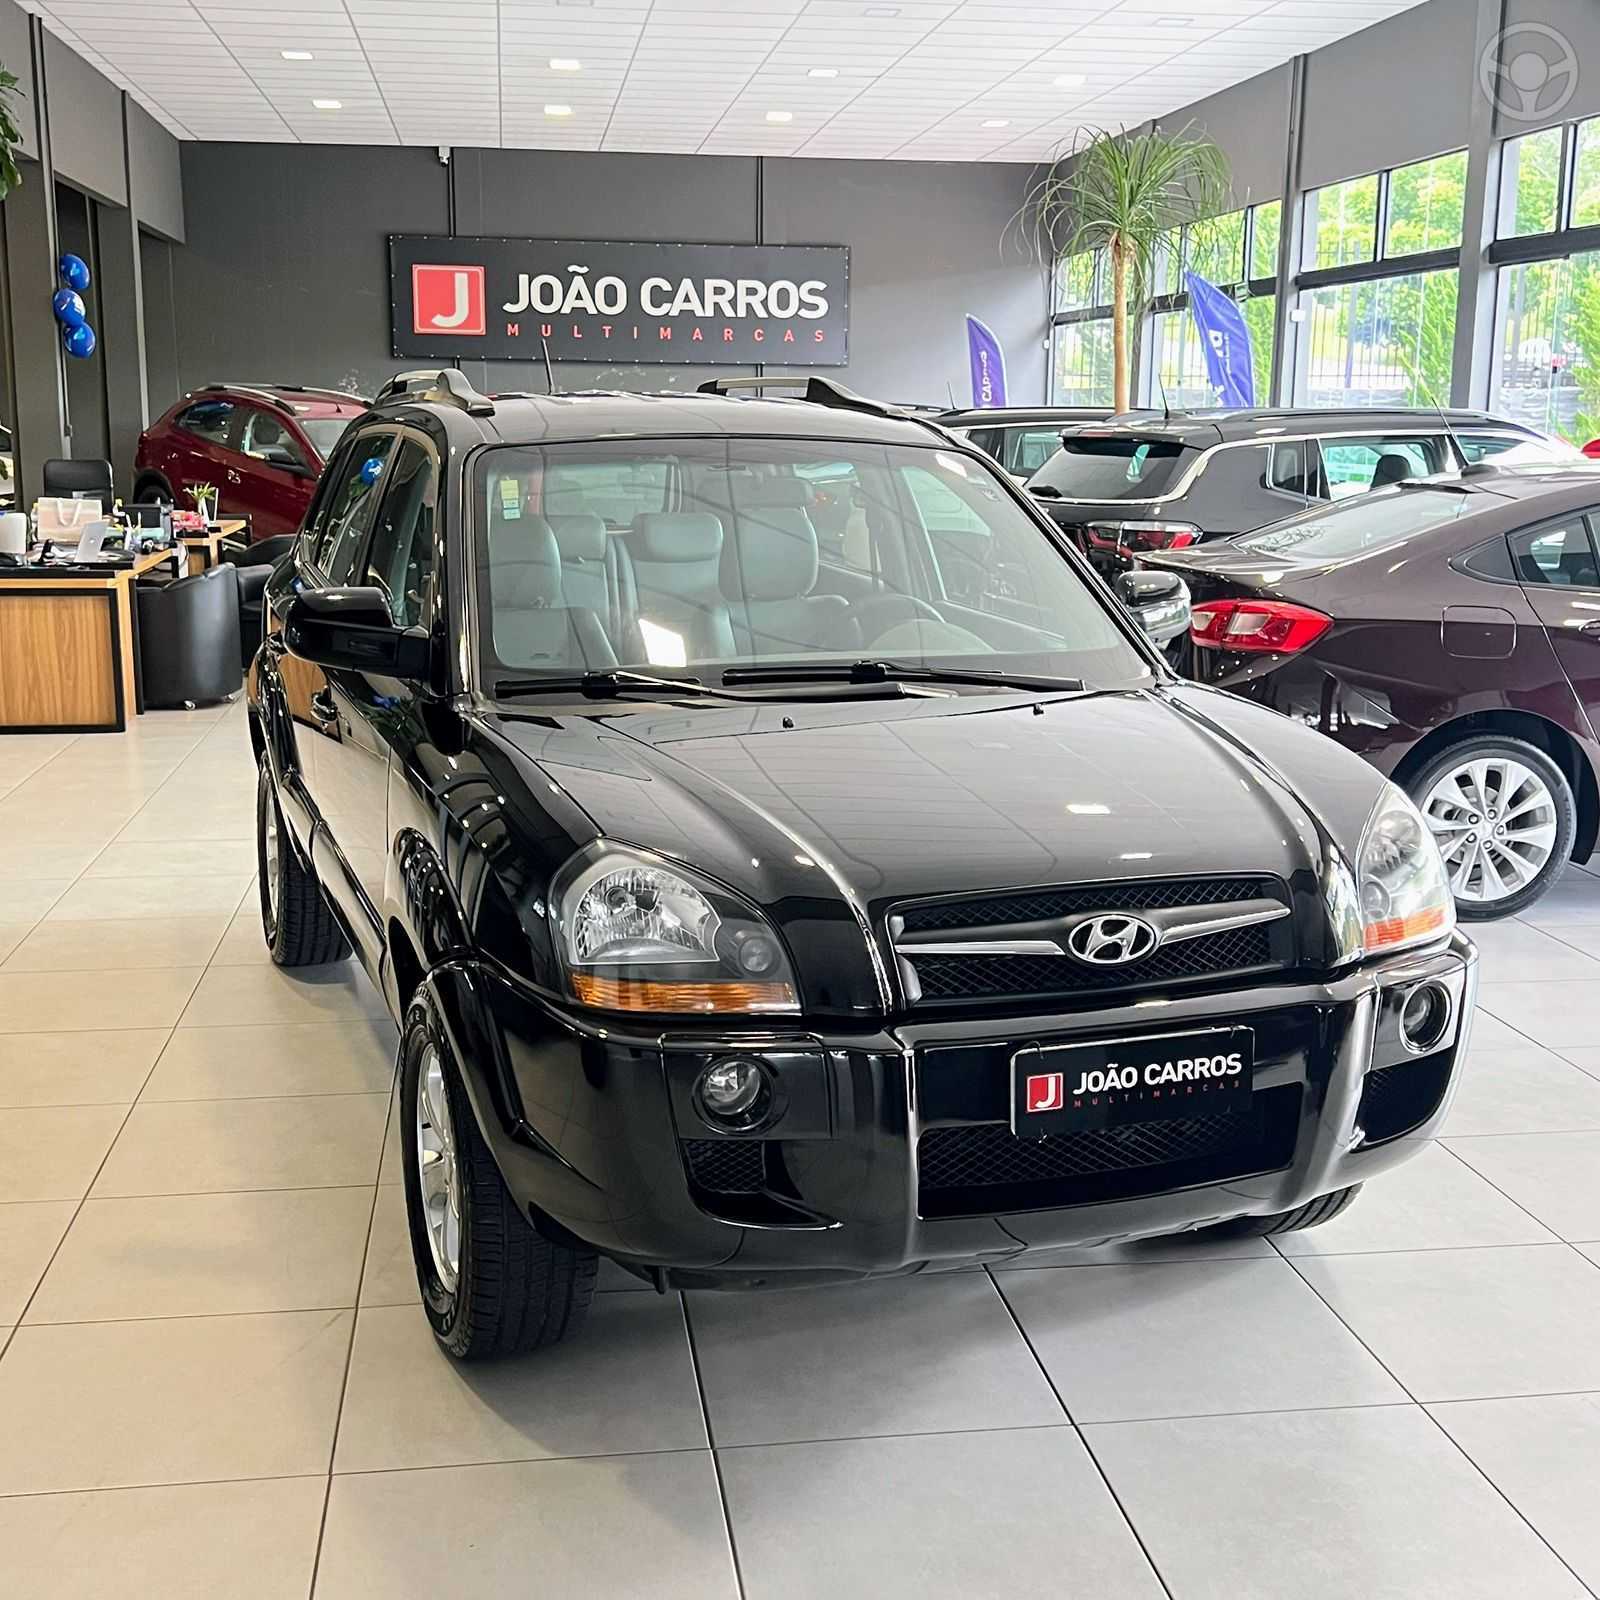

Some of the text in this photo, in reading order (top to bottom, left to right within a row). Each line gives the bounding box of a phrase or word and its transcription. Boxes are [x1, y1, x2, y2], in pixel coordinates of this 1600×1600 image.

[431, 271, 470, 328] J
[502, 264, 829, 320] JOÃO CARROS
[507, 322, 825, 343] MULTIMARCAS
[1035, 1076, 1057, 1109] J
[1073, 1053, 1242, 1095] JOÃO CARROS
[1073, 1079, 1241, 1108] MULTIMARCAS
